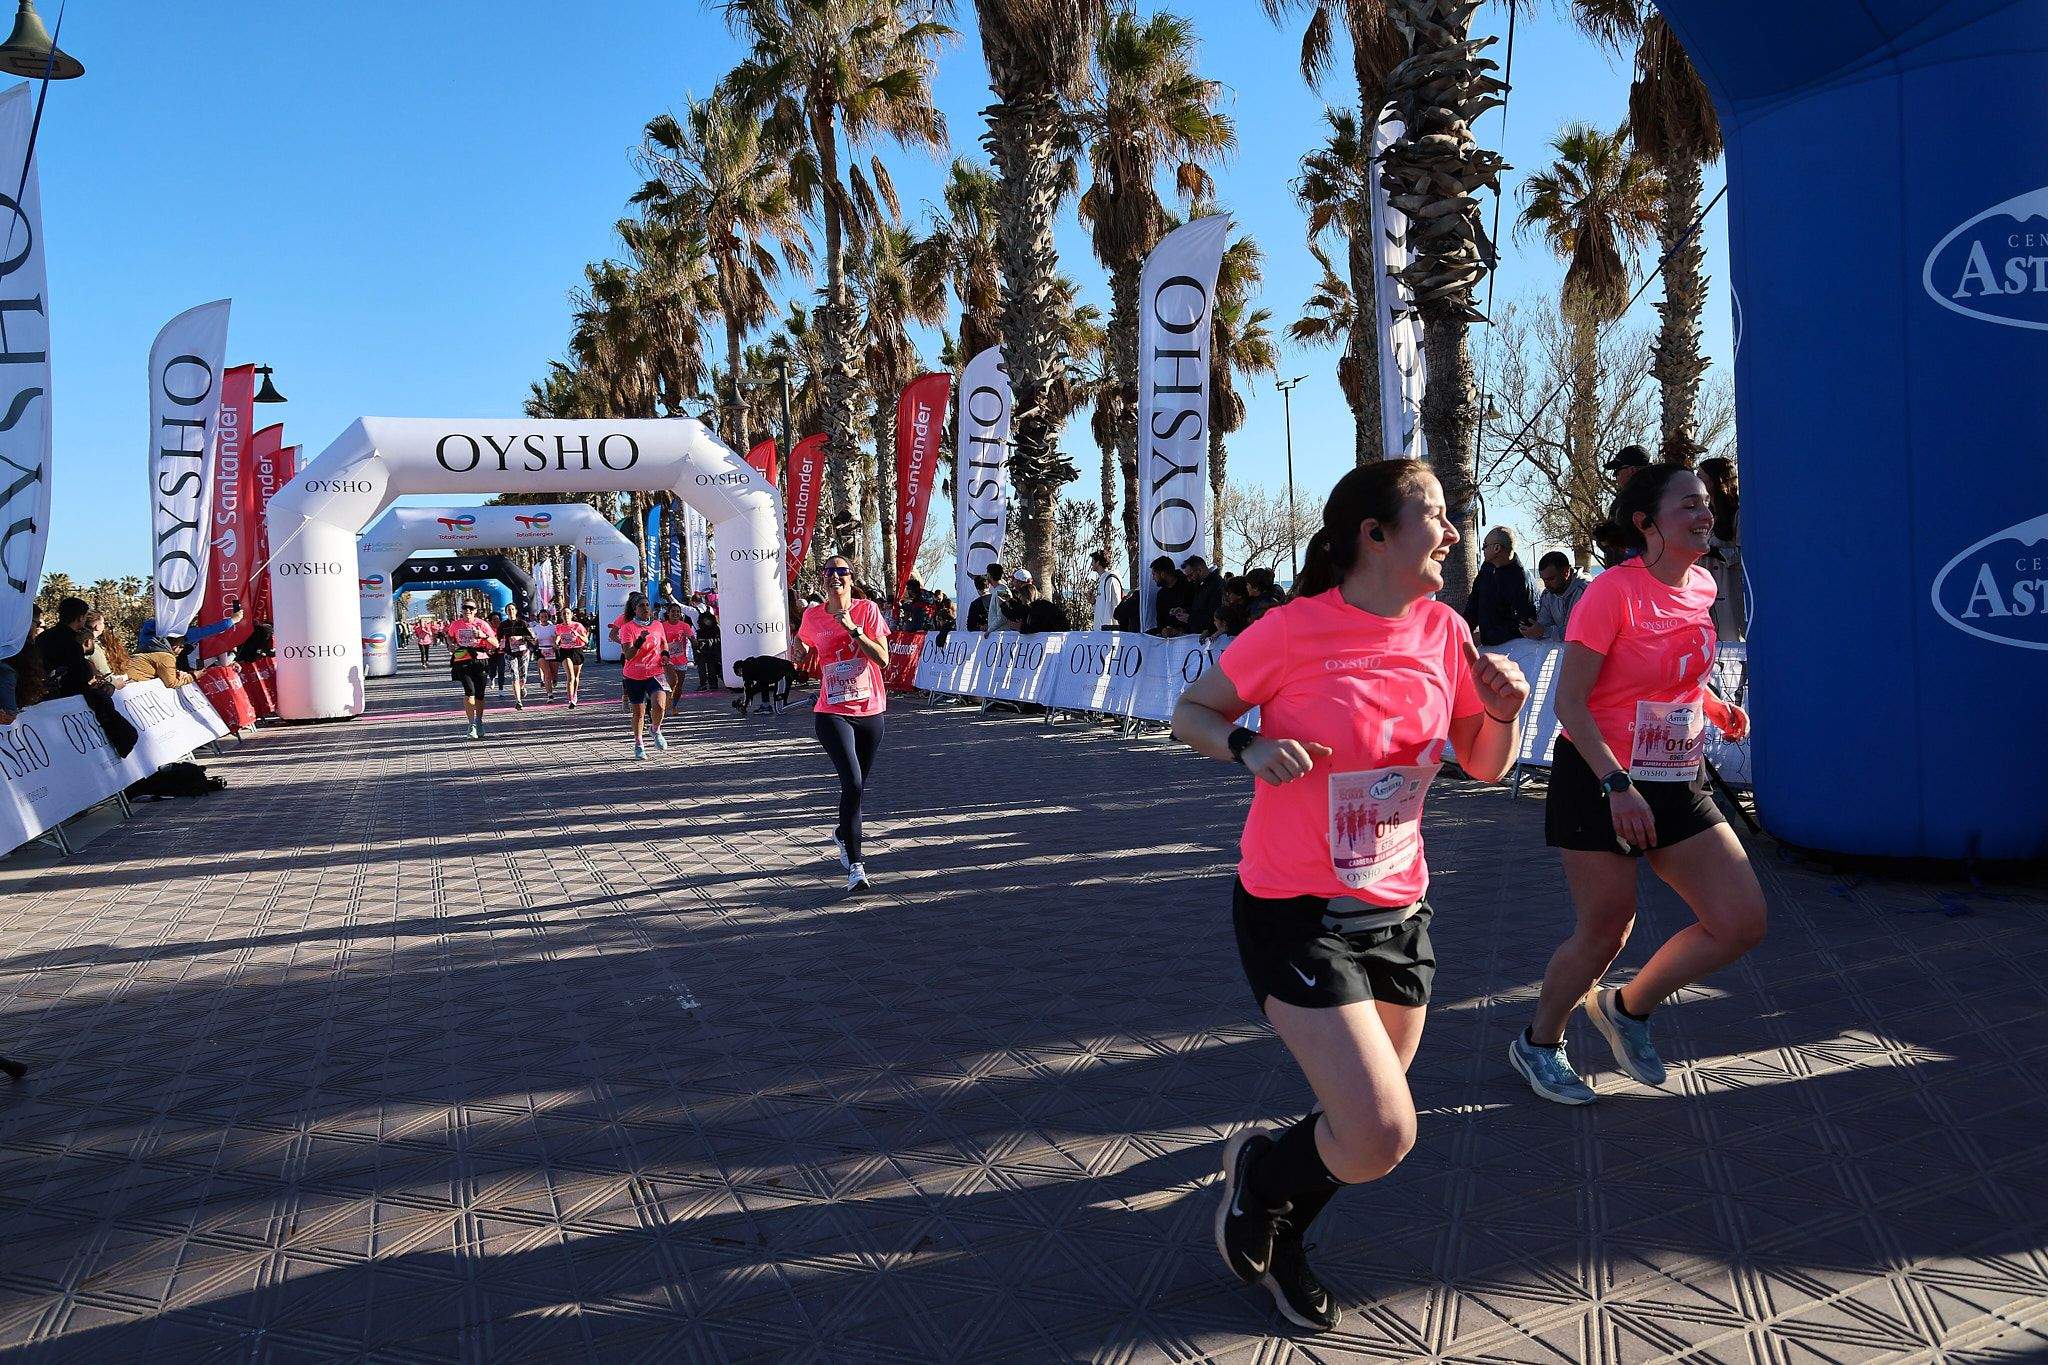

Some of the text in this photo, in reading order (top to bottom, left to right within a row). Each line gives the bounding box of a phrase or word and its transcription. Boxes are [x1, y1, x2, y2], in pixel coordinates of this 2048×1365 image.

[1151, 275, 1207, 555] OYSHO
[436, 434, 639, 473] OYSHO
[907, 402, 931, 508] Santander
[216, 402, 239, 524] Santander
[158, 354, 213, 600] OYSHO
[696, 473, 750, 486] OYSHO
[967, 386, 1004, 580] OYSHO
[305, 480, 372, 493] OYSHO
[793, 458, 814, 536] Santander
[730, 549, 780, 562] OYSHO
[279, 562, 342, 576] OYSHO
[411, 563, 489, 573] VOLVO
[735, 621, 784, 635] OYSHO
[1641, 619, 1678, 630] OYSHO
[284, 644, 346, 658] OYSHO
[986, 641, 1044, 671] OYSHO
[1070, 643, 1143, 678] OYSHO
[1325, 657, 1380, 670] OYSHO
[1665, 738, 1694, 752] 016
[1640, 769, 1668, 777] OYSHO
[1375, 811, 1400, 839] 016
[1346, 868, 1380, 882] OYSHO
